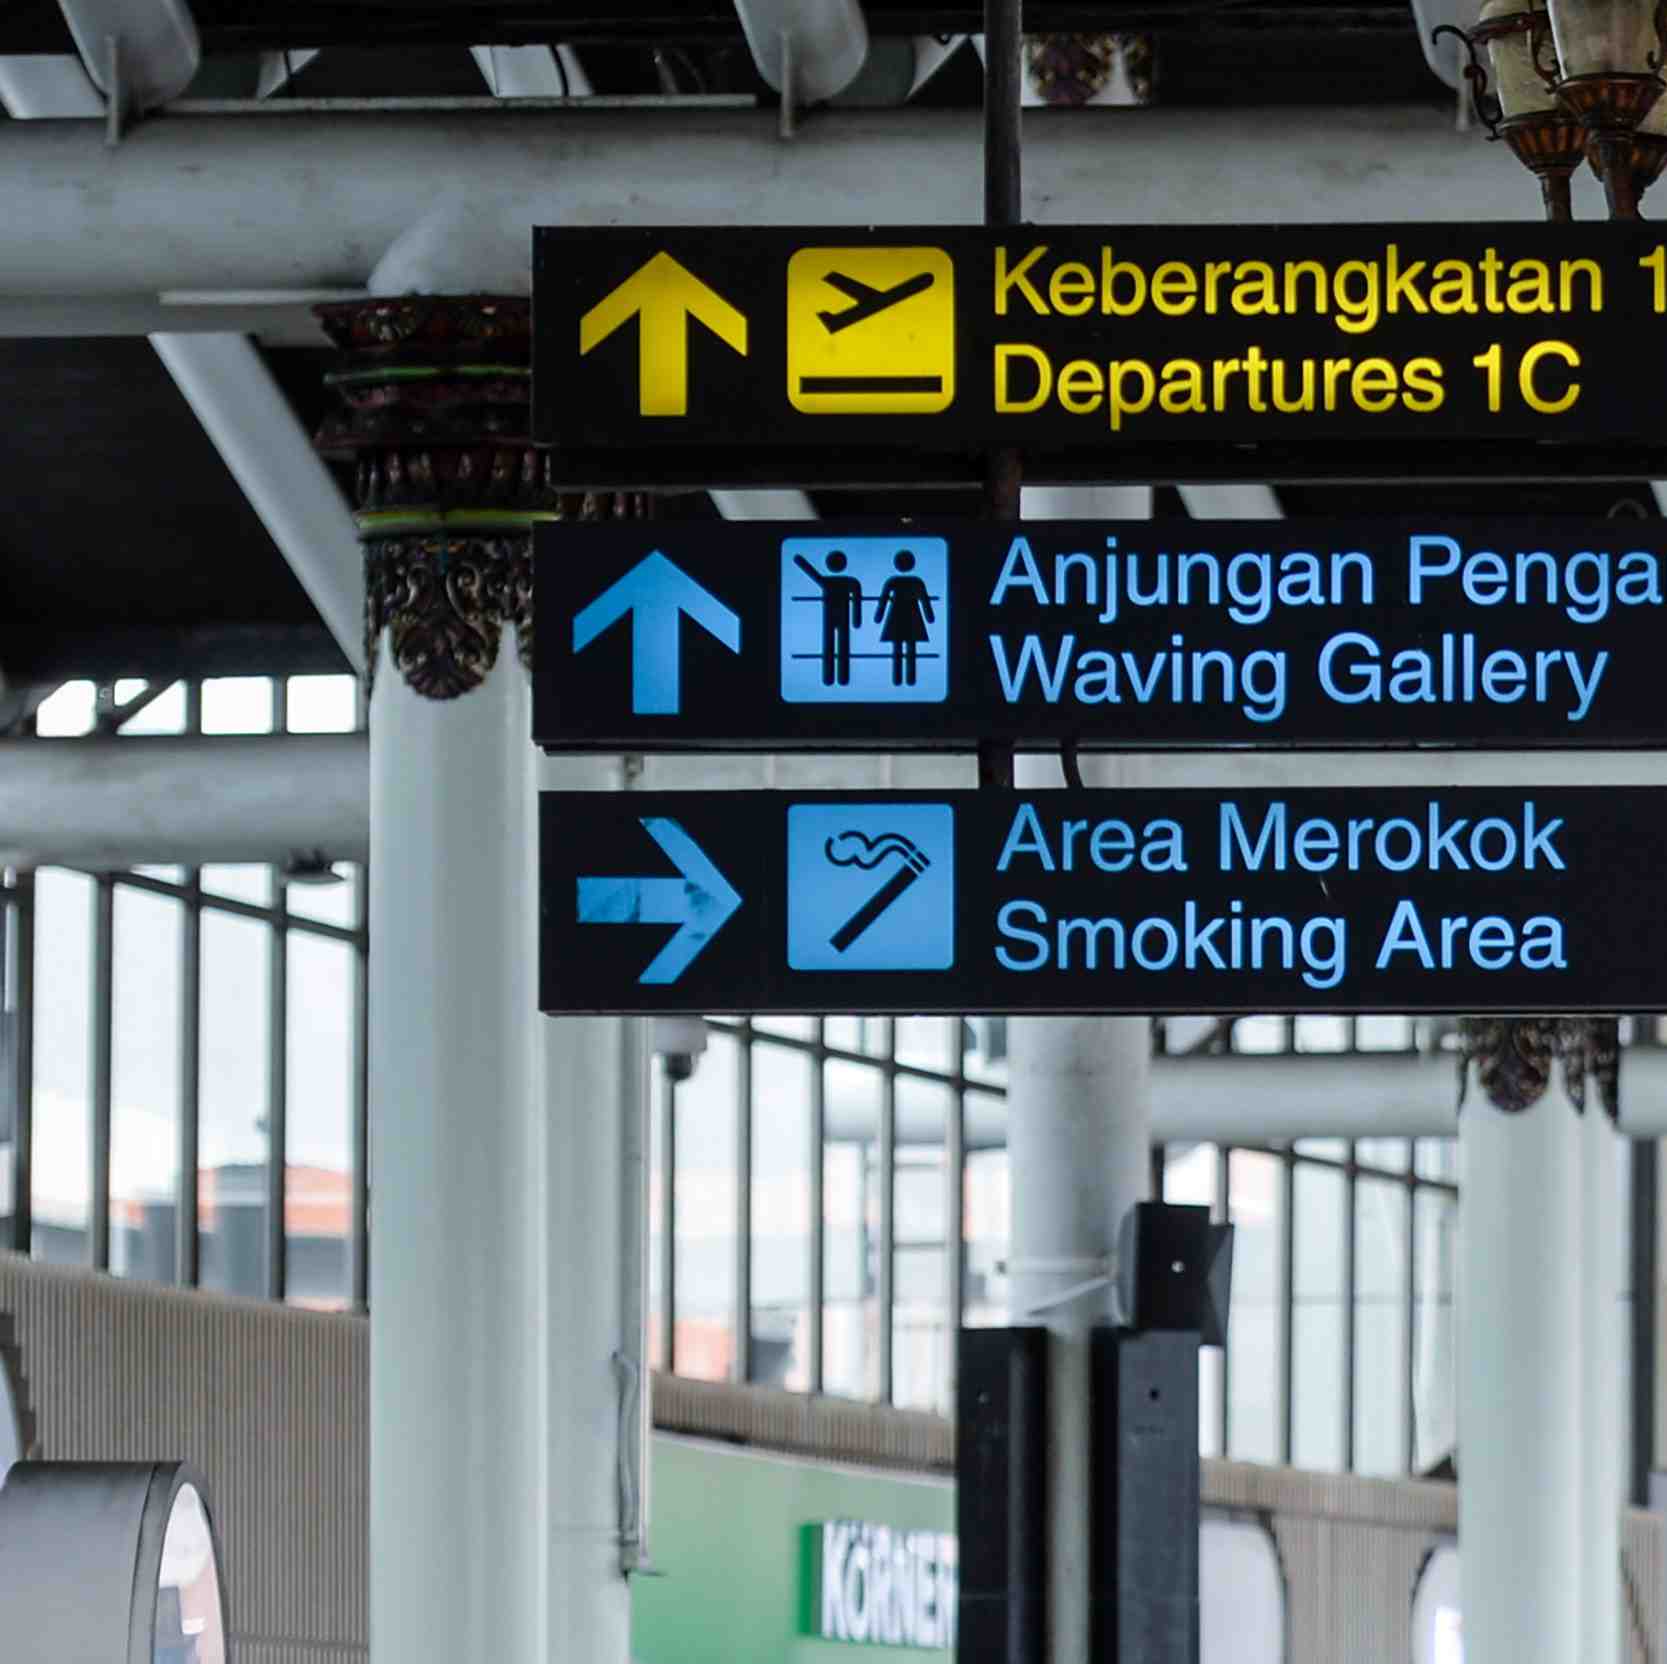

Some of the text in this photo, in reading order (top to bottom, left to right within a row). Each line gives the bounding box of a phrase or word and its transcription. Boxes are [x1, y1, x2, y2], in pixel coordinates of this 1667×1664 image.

[994, 244, 1603, 334] Keberangkatan
[994, 341, 1581, 431] Departures 1C
[989, 536, 1374, 625] Anjungan
[989, 631, 1609, 723] Waving Gallery
[996, 800, 1566, 872] Area Merokok
[995, 898, 1568, 986] Smoking Area
